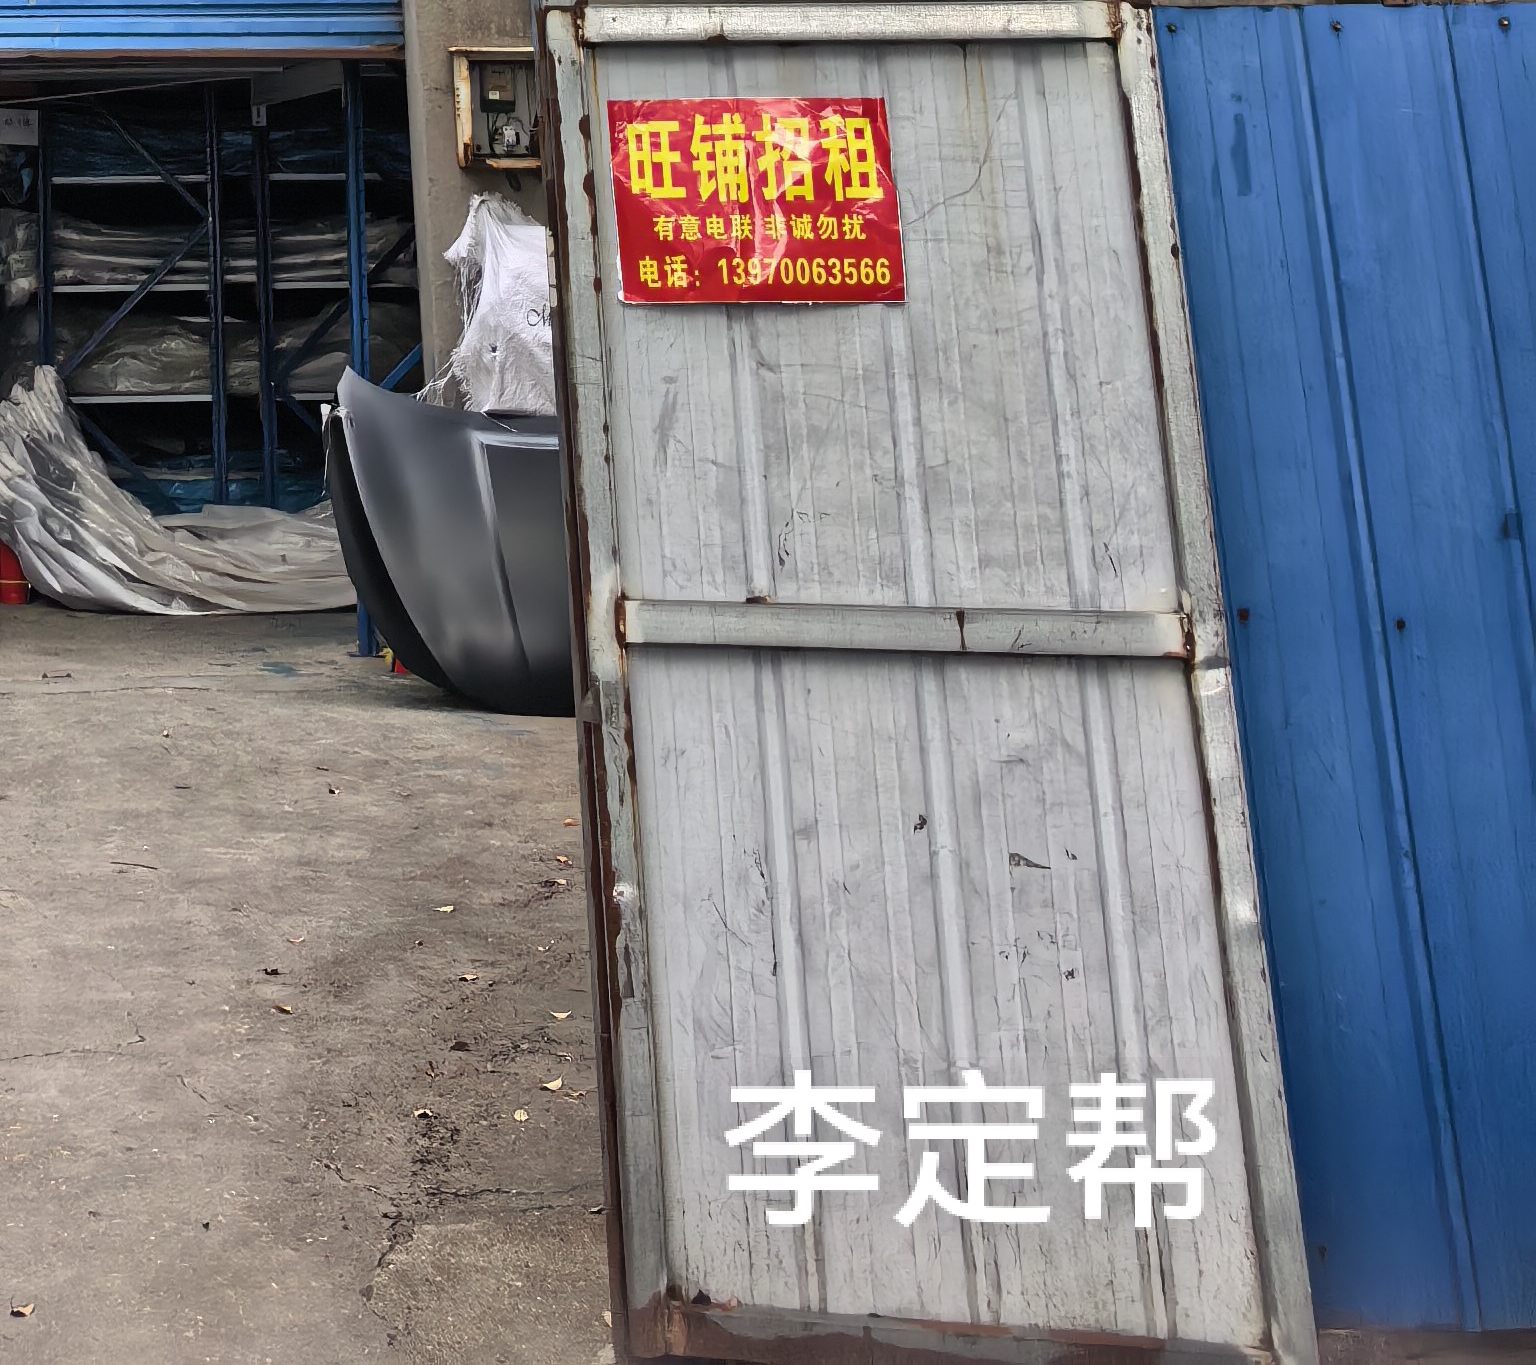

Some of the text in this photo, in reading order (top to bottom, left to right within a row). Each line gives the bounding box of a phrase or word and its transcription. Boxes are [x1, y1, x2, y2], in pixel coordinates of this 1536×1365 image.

[626, 113, 884, 202] 旺铺招租
[717, 257, 891, 286] 13970063566
